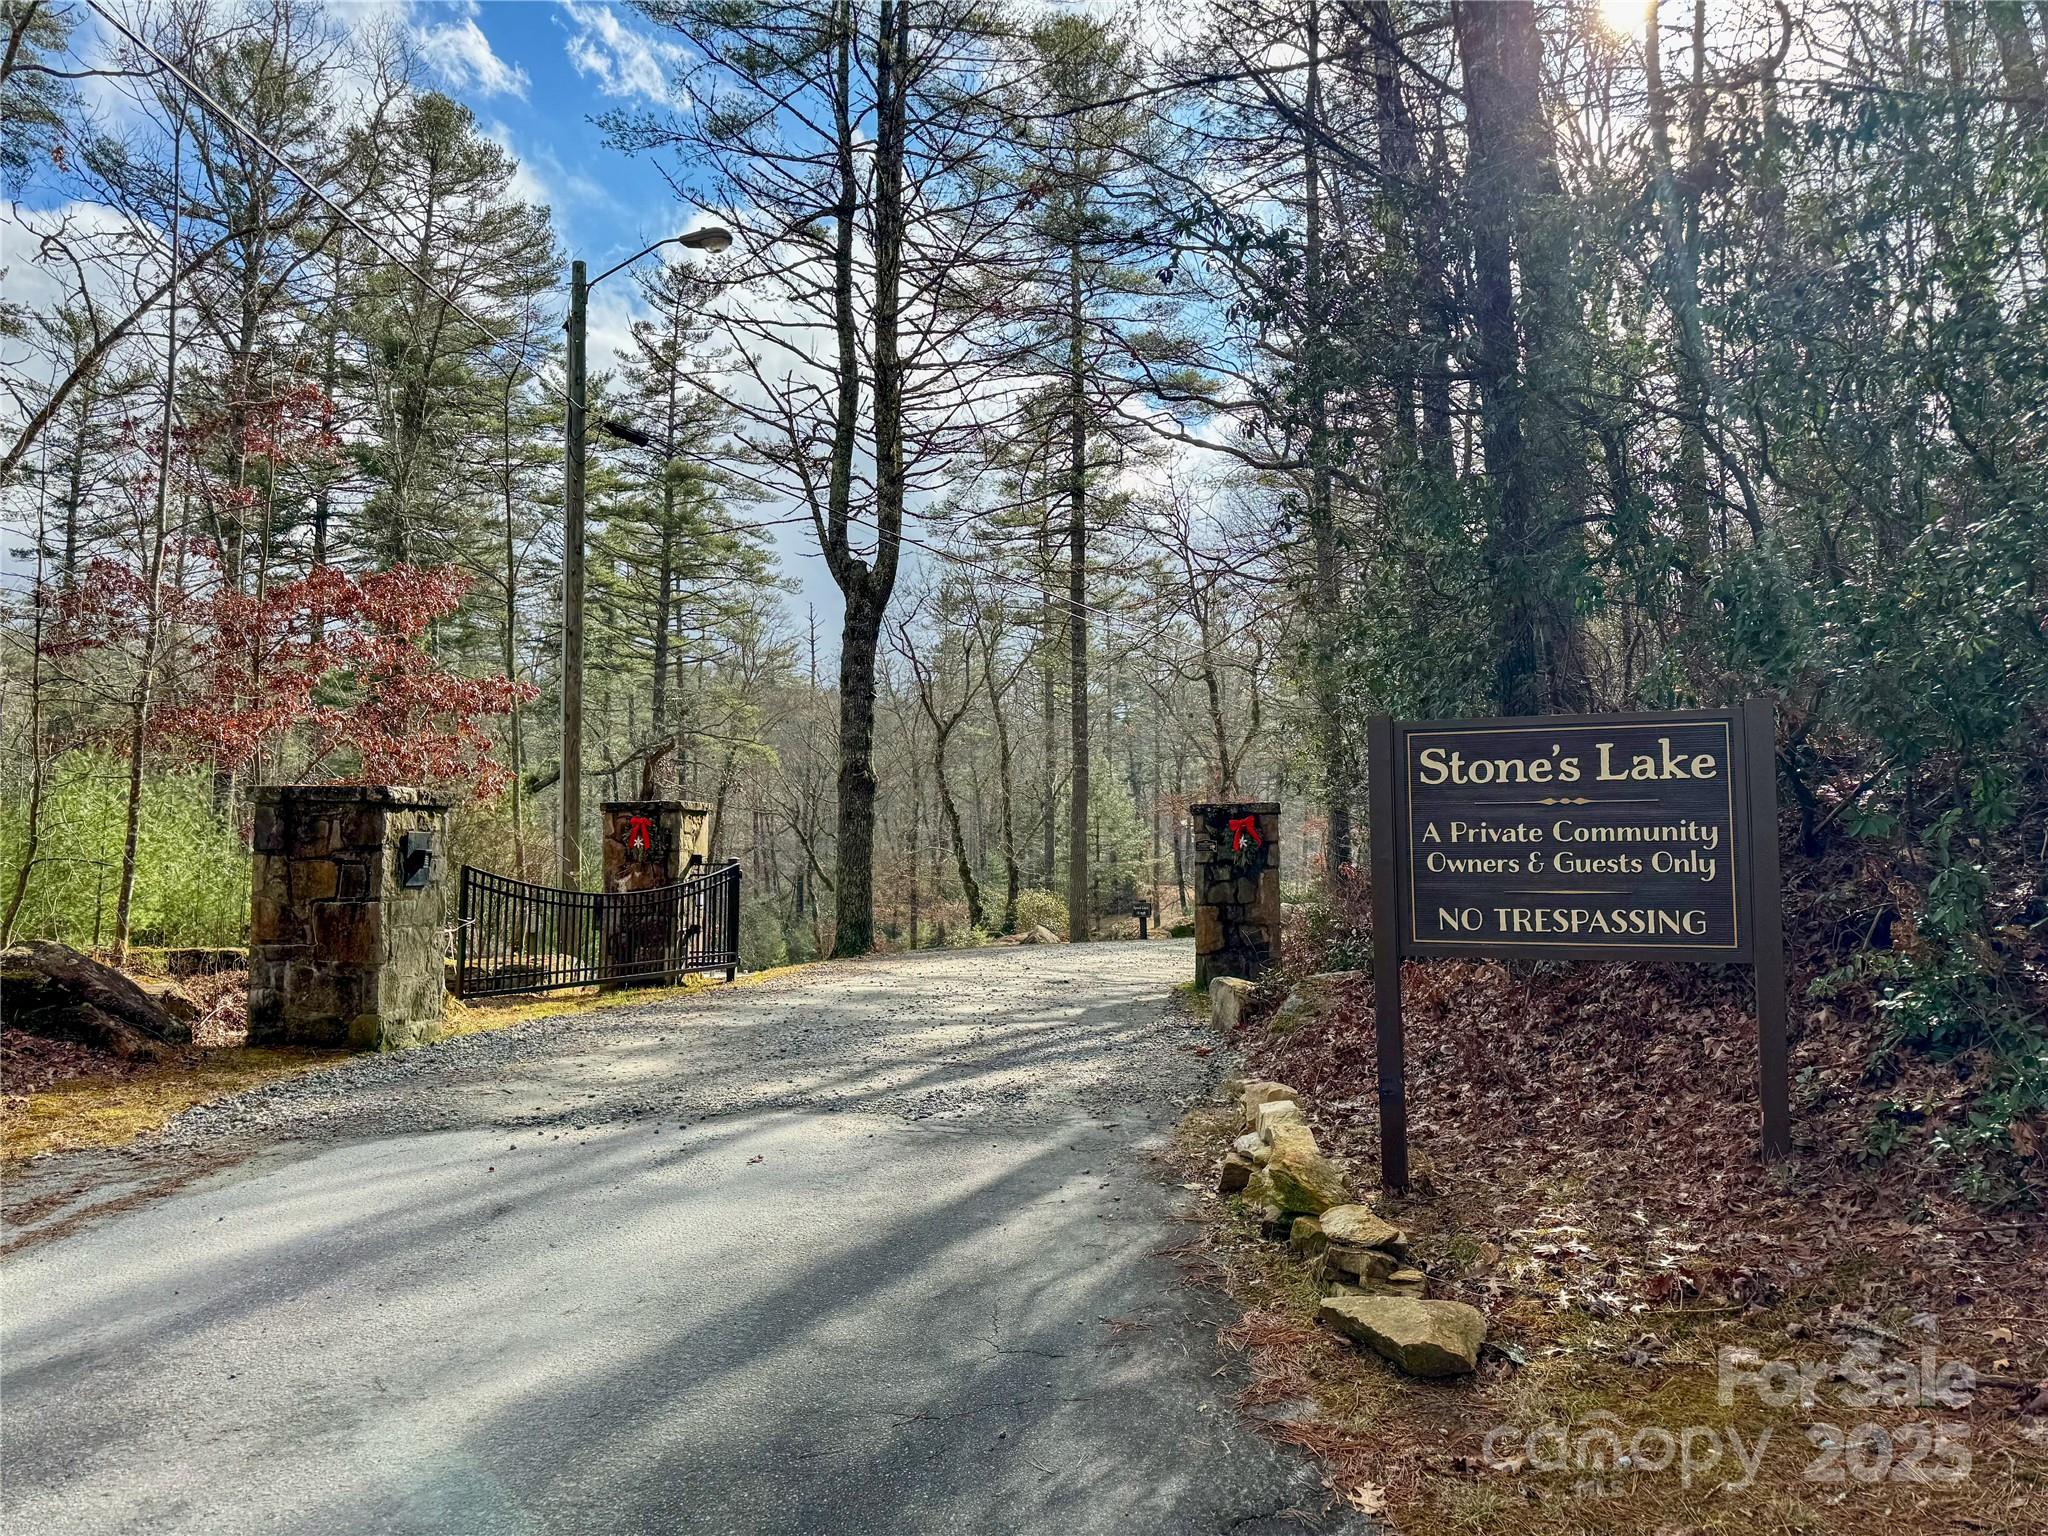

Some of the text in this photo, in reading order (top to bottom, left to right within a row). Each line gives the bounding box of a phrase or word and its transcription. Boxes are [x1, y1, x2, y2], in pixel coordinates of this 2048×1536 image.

[1419, 737, 1717, 785] Stone's Lake
[1422, 819, 1719, 850] A Private Community
[1426, 850, 1716, 882] Owners & Guests Only
[1438, 907, 1707, 936] NO TRESPASSING
